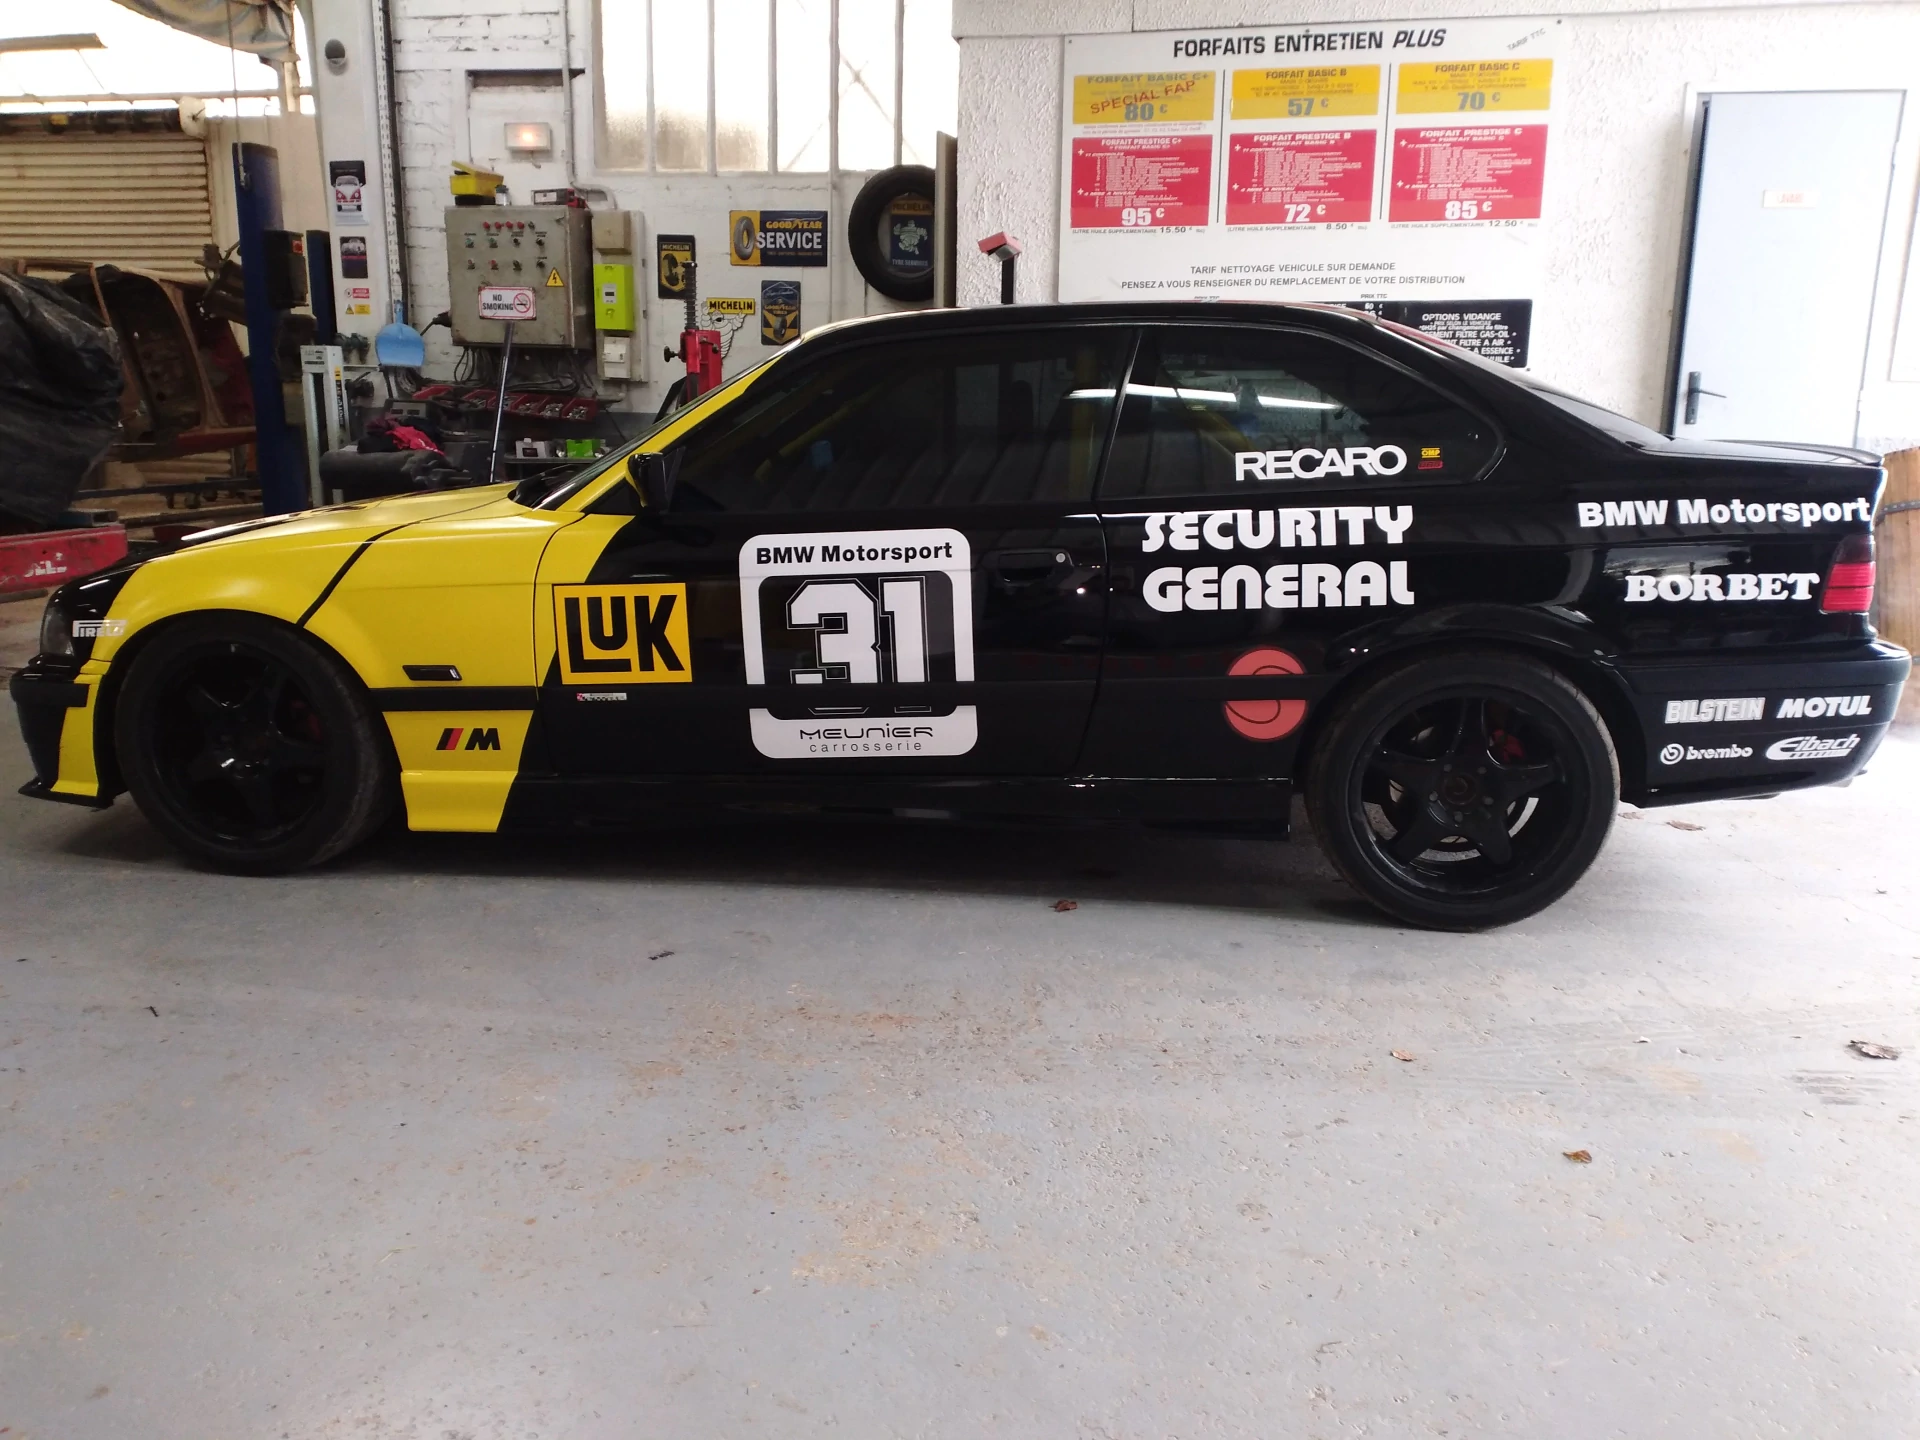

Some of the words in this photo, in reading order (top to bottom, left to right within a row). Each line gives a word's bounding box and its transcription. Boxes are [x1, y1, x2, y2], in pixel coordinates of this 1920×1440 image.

[1173, 35, 1266, 58] FORFAITS
[1274, 31, 1384, 54] ENTRETIEN
[1392, 28, 1447, 48] PLUS
[1265, 70, 1305, 80] FORFAIT
[1308, 68, 1337, 78] BASIC
[1435, 63, 1476, 73] FORFAIT
[1479, 62, 1509, 72] BASIC
[1087, 74, 1143, 84] FORFAIT
[1147, 72, 1188, 82] BASIC
[1090, 89, 1160, 114] SPECIAL
[1164, 80, 1196, 96] FAP
[1457, 91, 1486, 111] 70
[1124, 102, 1154, 121] 80
[1287, 98, 1315, 117] 57
[1133, 138, 1170, 146] PRESTIGE
[1253, 134, 1293, 143] FORFAIT
[1295, 132, 1341, 140] PRESTIGE
[1420, 130, 1461, 138] FORFAIT
[1463, 128, 1511, 136] PRESTIGE
[1121, 207, 1152, 226] 95
[1284, 203, 1312, 223] 72
[1445, 200, 1478, 219] 85
[1160, 226, 1187, 234] 15.50
[1325, 223, 1348, 231] 8.50
[756, 231, 822, 249] SERVICE
[1190, 265, 1217, 274] TARIF
[1220, 264, 1275, 274] NETTOYAGE
[1278, 263, 1325, 273] VEHICULE
[1327, 263, 1347, 271] SUR
[1349, 262, 1396, 271] DEMANDE
[1121, 280, 1156, 289] PENSEZ
[1157, 280, 1164, 288] A
[1166, 279, 1191, 288] VOUS
[1193, 278, 1252, 288] RENSEIGNER
[1254, 278, 1267, 287] DU
[1269, 276, 1347, 286] REMPLACEMENT
[1349, 276, 1362, 284] DE
[1363, 276, 1397, 284] VOTRE
[1399, 275, 1466, 284] DISTRIBUTION
[482, 302, 514, 311] SMOKING
[492, 294, 503, 302] NO
[709, 300, 753, 310] MICHELIN
[1421, 313, 1460, 321] OPTIONS
[1463, 312, 1502, 320] VIDANGE
[1479, 330, 1509, 338] GAS-OIL
[1491, 338, 1505, 346] AIR
[1481, 347, 1514, 355] ESSENCE
[1235, 444, 1408, 481] RECARO
[1577, 499, 1668, 527] BMW
[1677, 497, 1871, 527] Motorsport
[1142, 505, 1414, 553] SECURITY
[756, 545, 815, 565] BMW
[821, 542, 953, 563] Motorsport
[1142, 560, 1415, 612] GENERAL
[1624, 572, 1820, 602] BORBET
[564, 594, 685, 673] LUK
[786, 576, 930, 686] 31
[1664, 697, 1766, 724] BILSTEIN
[1776, 695, 1873, 719] MOTUL
[464, 728, 501, 750] M
[809, 741, 922, 753] carrosserie
[1686, 743, 1753, 761] brembo
[1765, 733, 1861, 761] Eibach
